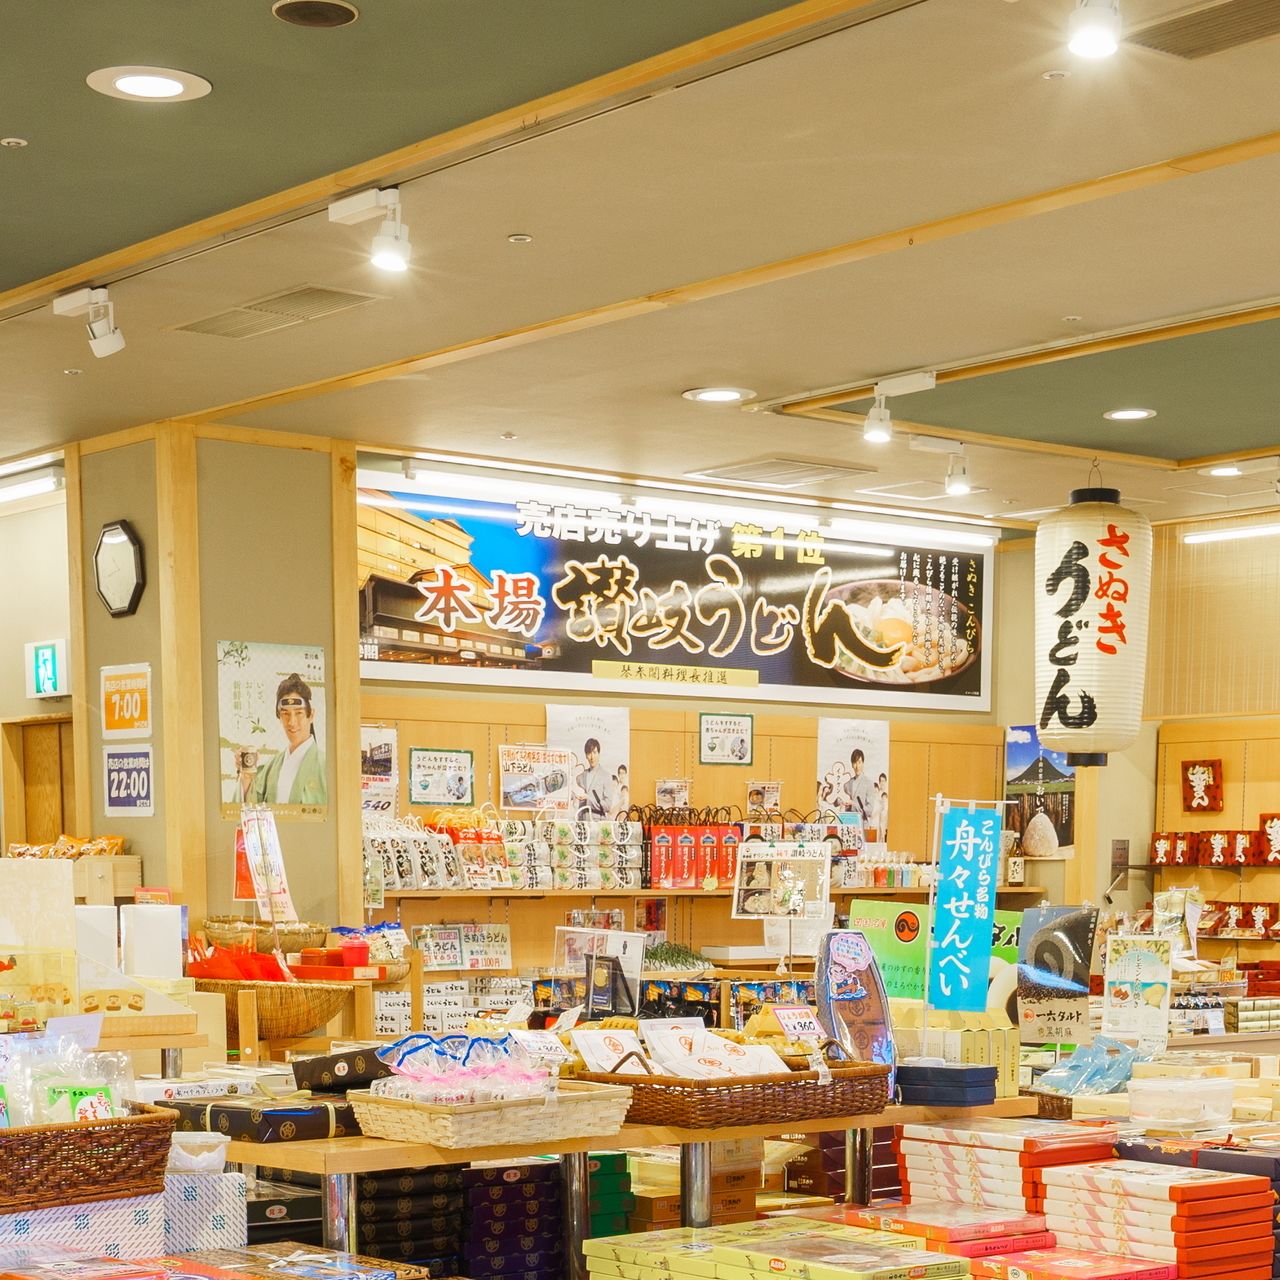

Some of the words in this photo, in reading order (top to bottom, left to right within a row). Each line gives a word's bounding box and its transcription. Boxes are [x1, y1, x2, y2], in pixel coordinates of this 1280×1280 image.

[517, 500, 722, 554] 売店売り上げ
[732, 522, 825, 565] 第1位
[965, 559, 977, 596] さぬき
[1095, 524, 1131, 655] さぬき
[416, 564, 546, 638] 本場
[552, 554, 905, 668] 讃岐うどん
[965, 602, 977, 654] こんぴら
[1040, 541, 1098, 732] うどん
[111, 692, 141, 721] 7:00
[110, 771, 148, 798] 22:00
[361, 801, 391, 811] 540
[974, 820, 994, 920] こんぴら名物
[939, 819, 982, 996] 舟々せんべい
[463, 932, 507, 944] さぬきうどん
[1035, 1010, 1083, 1023] 一六タルト
